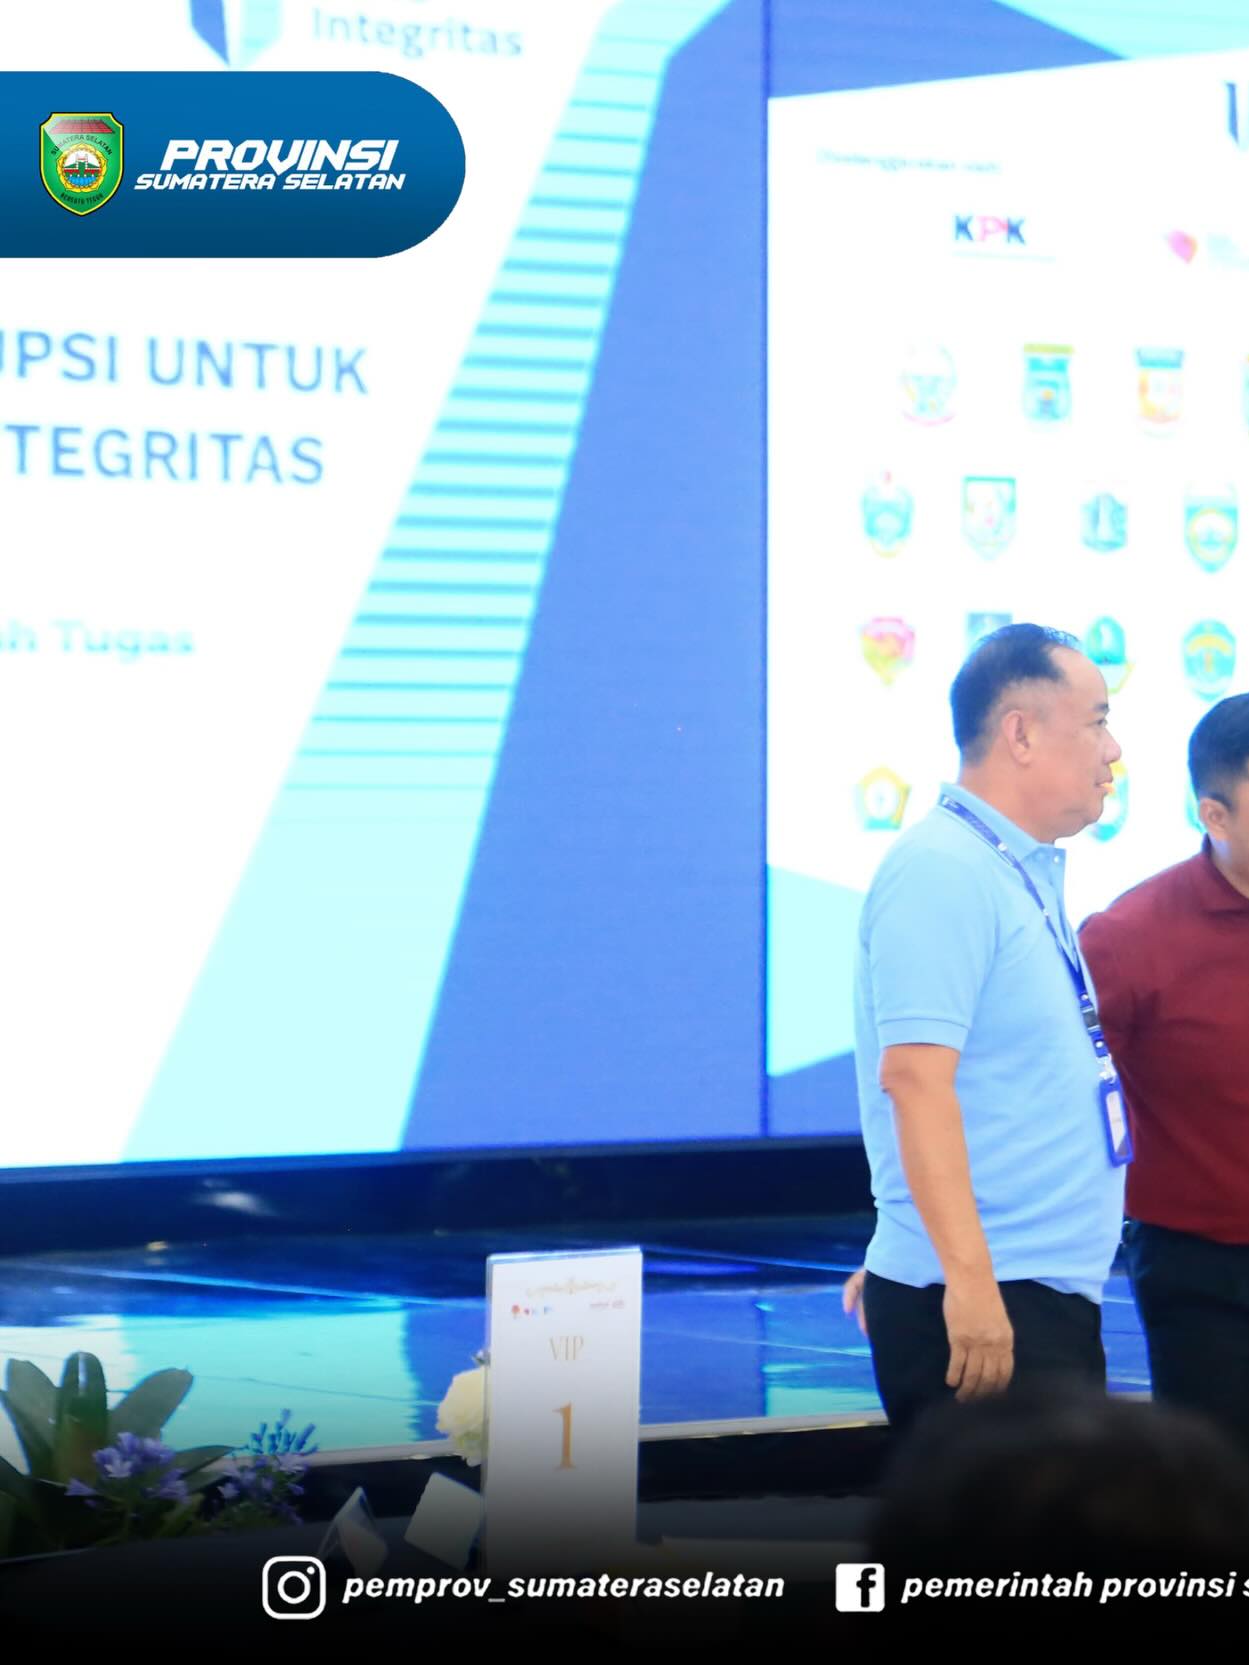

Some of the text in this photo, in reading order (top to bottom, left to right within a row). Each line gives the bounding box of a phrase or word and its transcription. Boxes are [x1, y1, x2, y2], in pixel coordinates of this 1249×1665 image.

[311, 7, 525, 58] Integritas
[953, 213, 1027, 246] KPK
[0, 330, 368, 394] PSI UNTUK
[549, 1335, 585, 1361] VIP
[551, 1400, 576, 1471] 1
